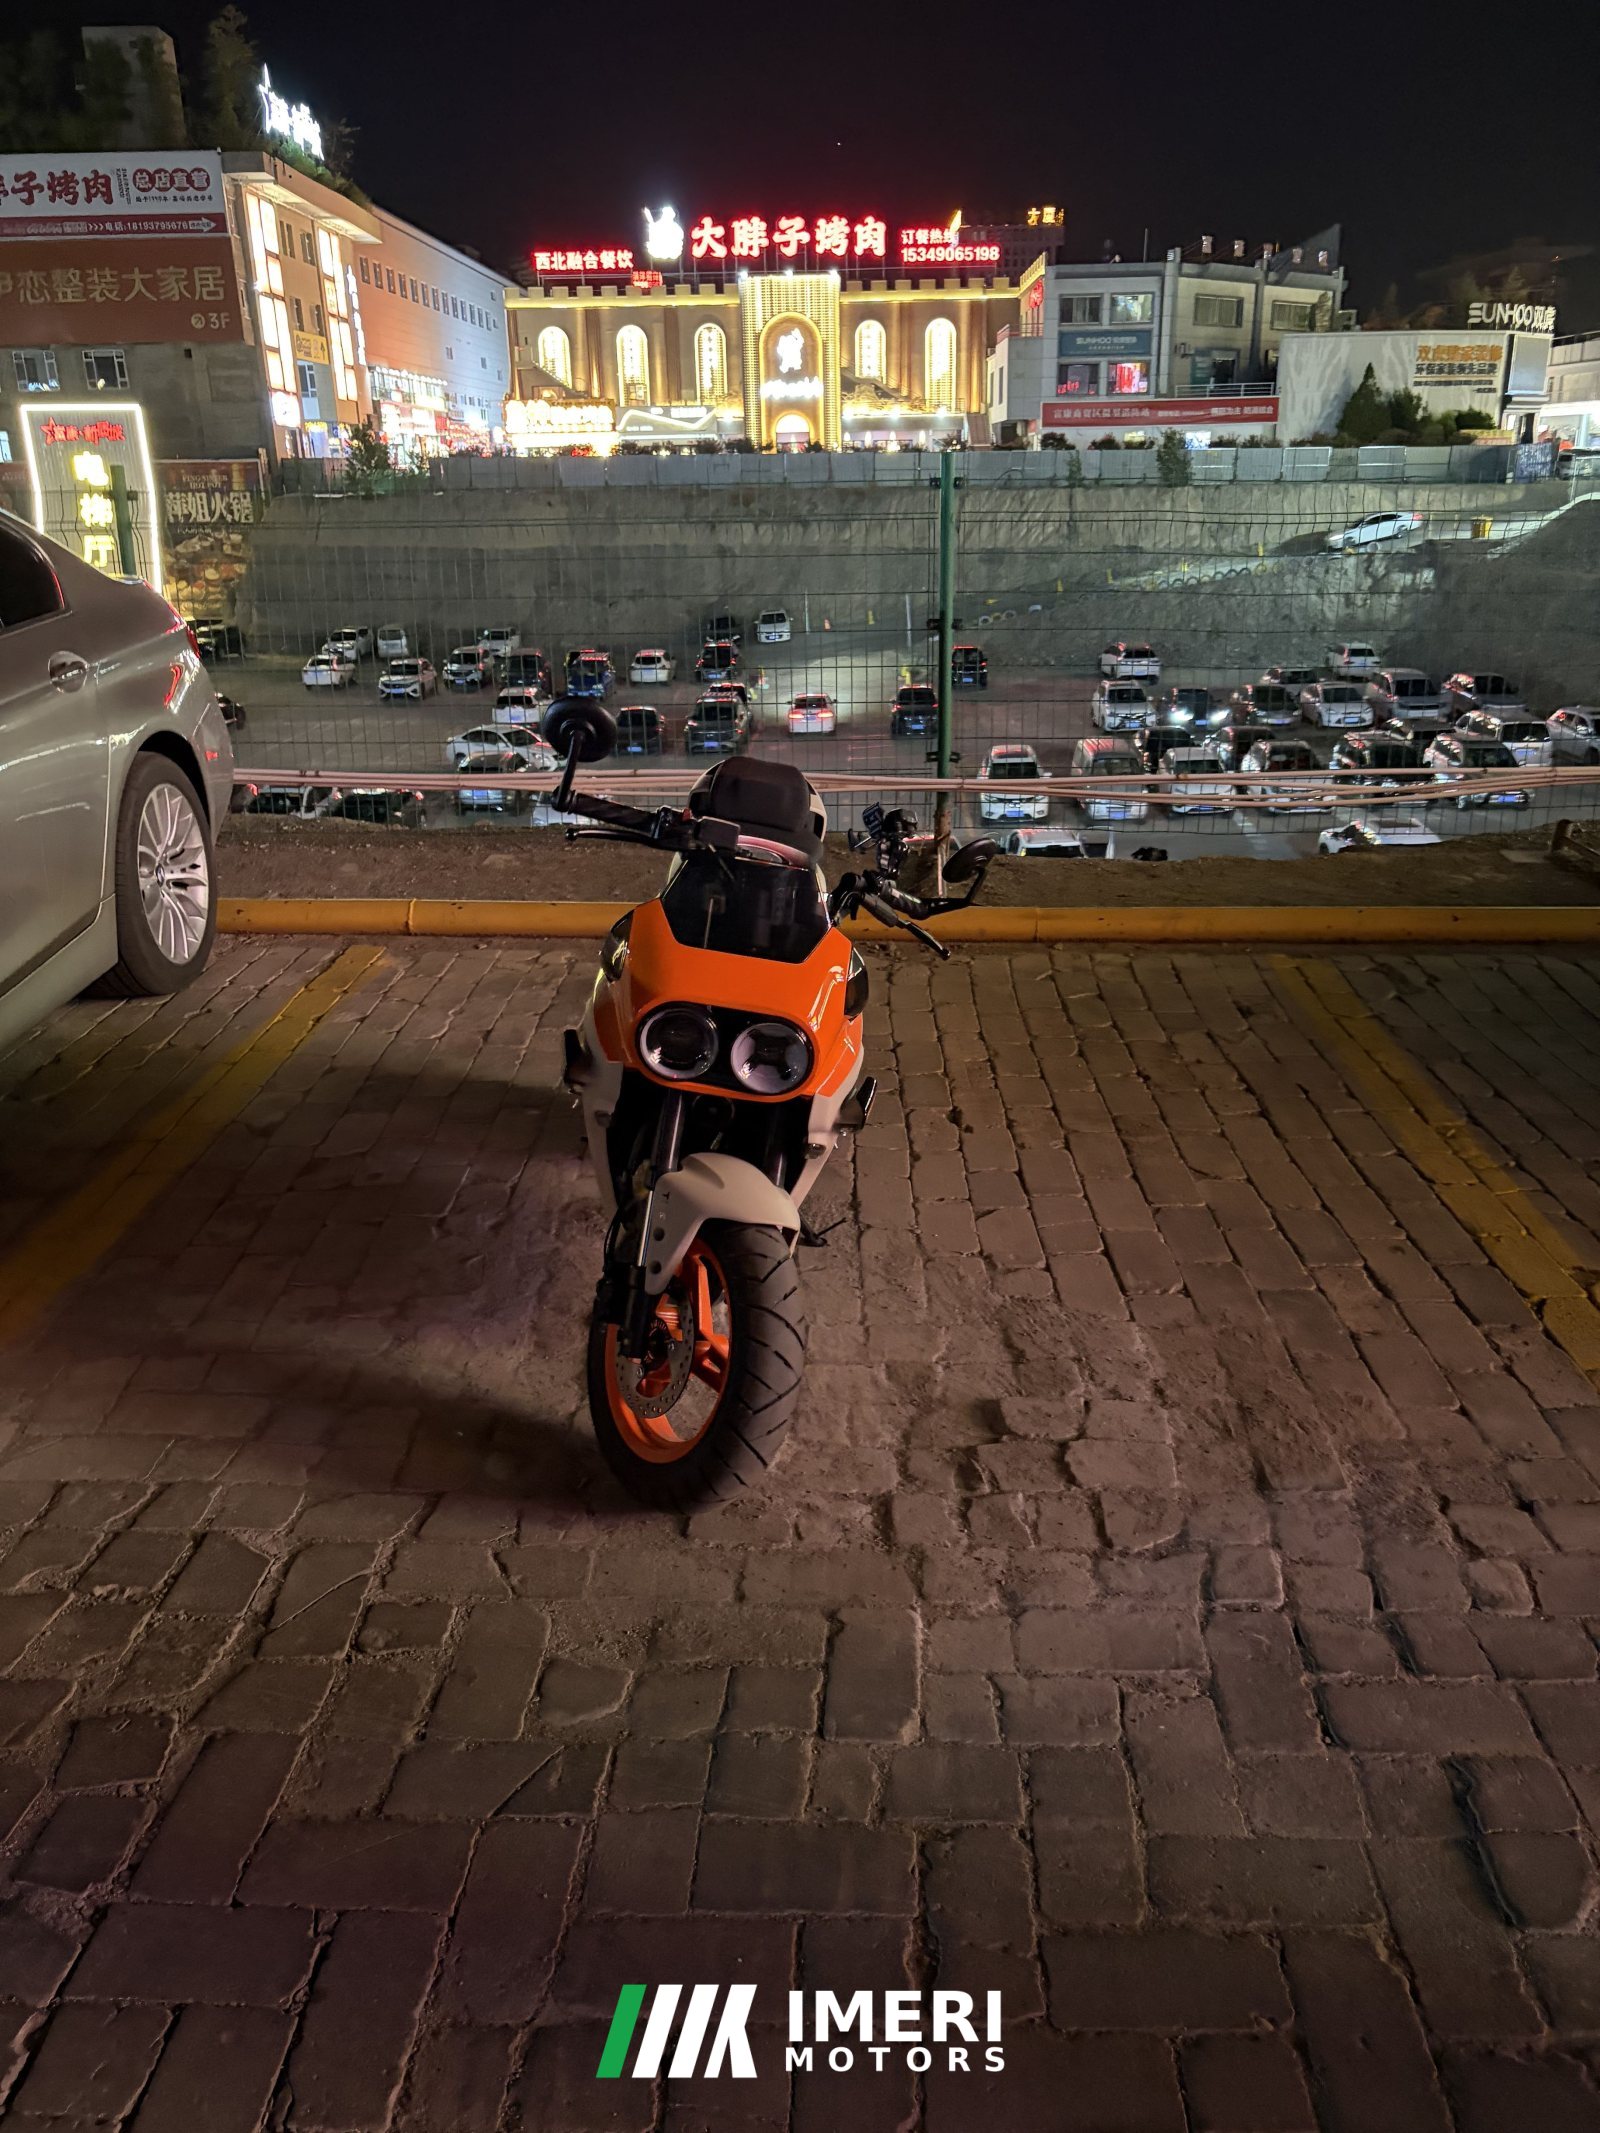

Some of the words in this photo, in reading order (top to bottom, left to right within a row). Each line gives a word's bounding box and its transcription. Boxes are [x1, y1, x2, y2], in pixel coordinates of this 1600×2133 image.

[691, 215, 887, 258] 大胖子烤肉
[533, 249, 634, 271] 西北融合餐饮
[901, 246, 1000, 262] 15349065198
[208, 312, 231, 329] 3F
